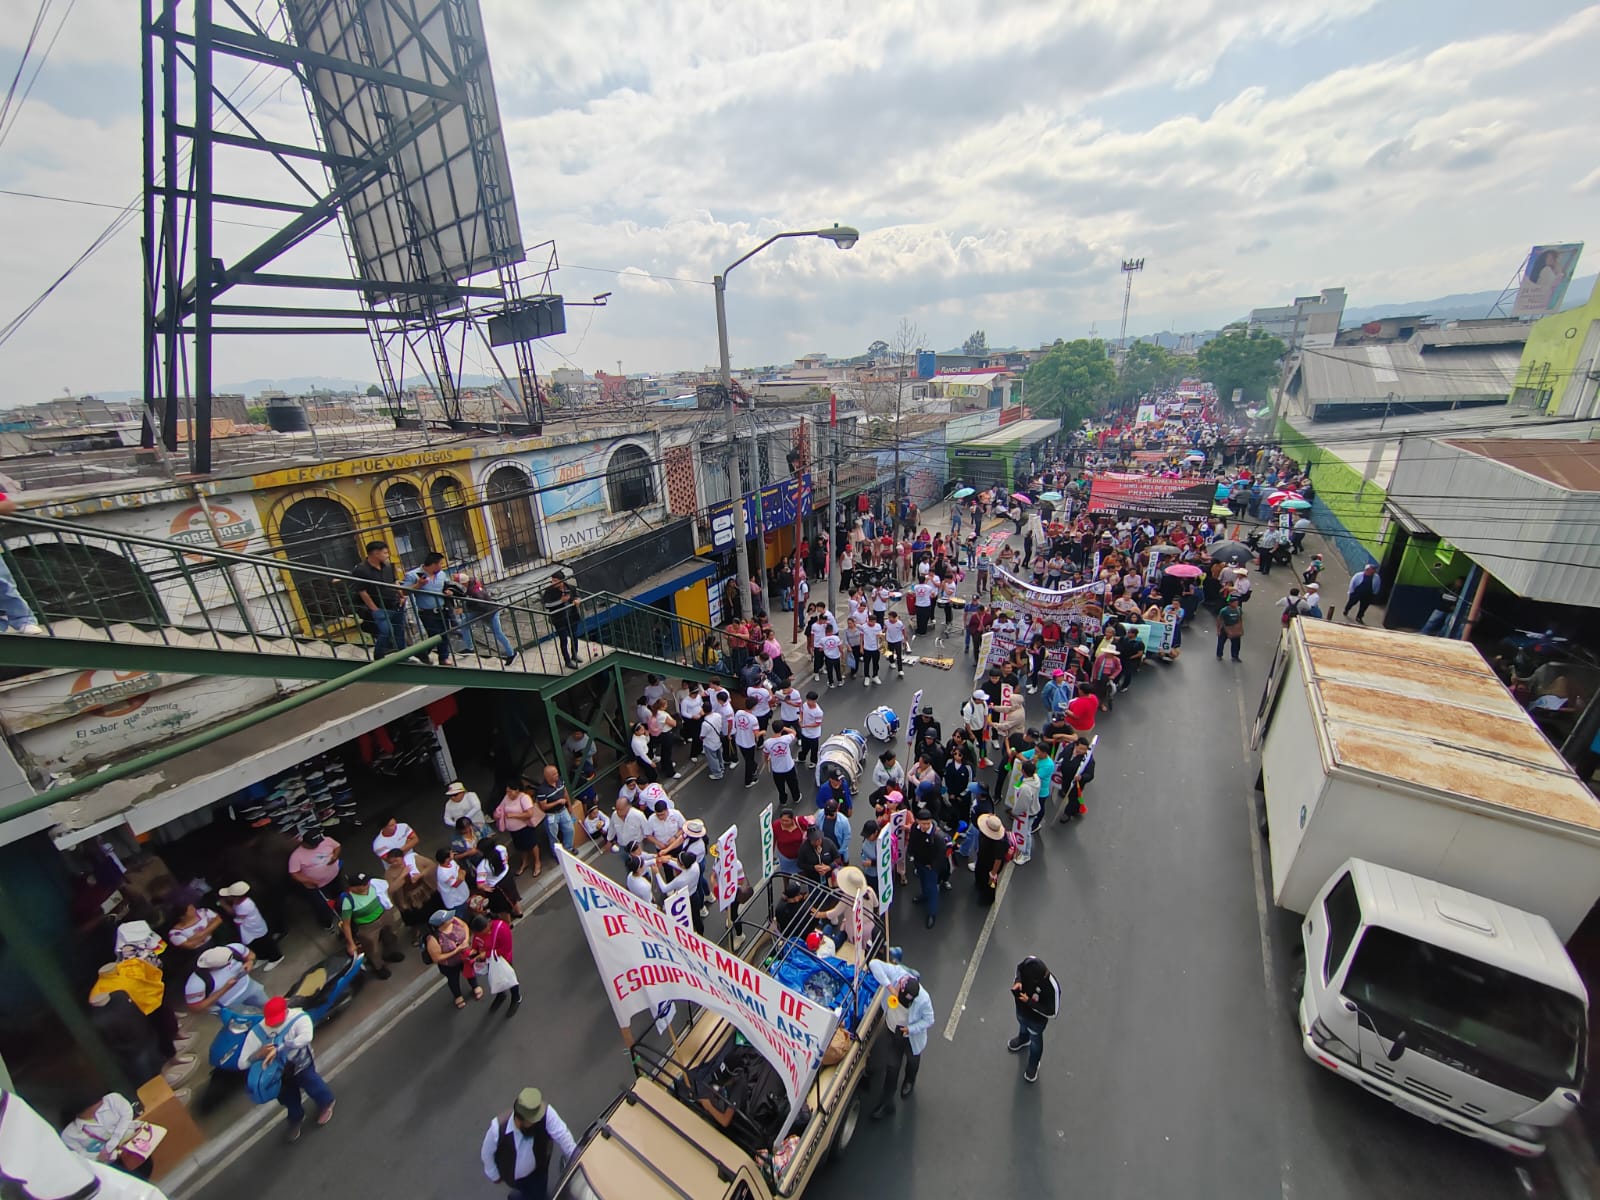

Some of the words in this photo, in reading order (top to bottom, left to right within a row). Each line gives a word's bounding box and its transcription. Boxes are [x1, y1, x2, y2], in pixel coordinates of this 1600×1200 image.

[351, 454, 411, 473] HUEVOS
[1149, 553, 1158, 575] CGT
[1025, 590, 1036, 600] DE
[1038, 593, 1062, 603] MAYO
[1162, 614, 1176, 650] CGTG
[76, 730, 87, 739] El
[90, 721, 119, 735] sabor
[123, 712, 141, 729] que
[140, 702, 178, 717] alimenta
[723, 832, 736, 901] CGTG
[880, 830, 893, 904] CGTG
[603, 914, 635, 937] DE
[641, 940, 682, 967] DEL
[673, 925, 769, 1002] GREMIAL
[779, 989, 814, 1030] DE
